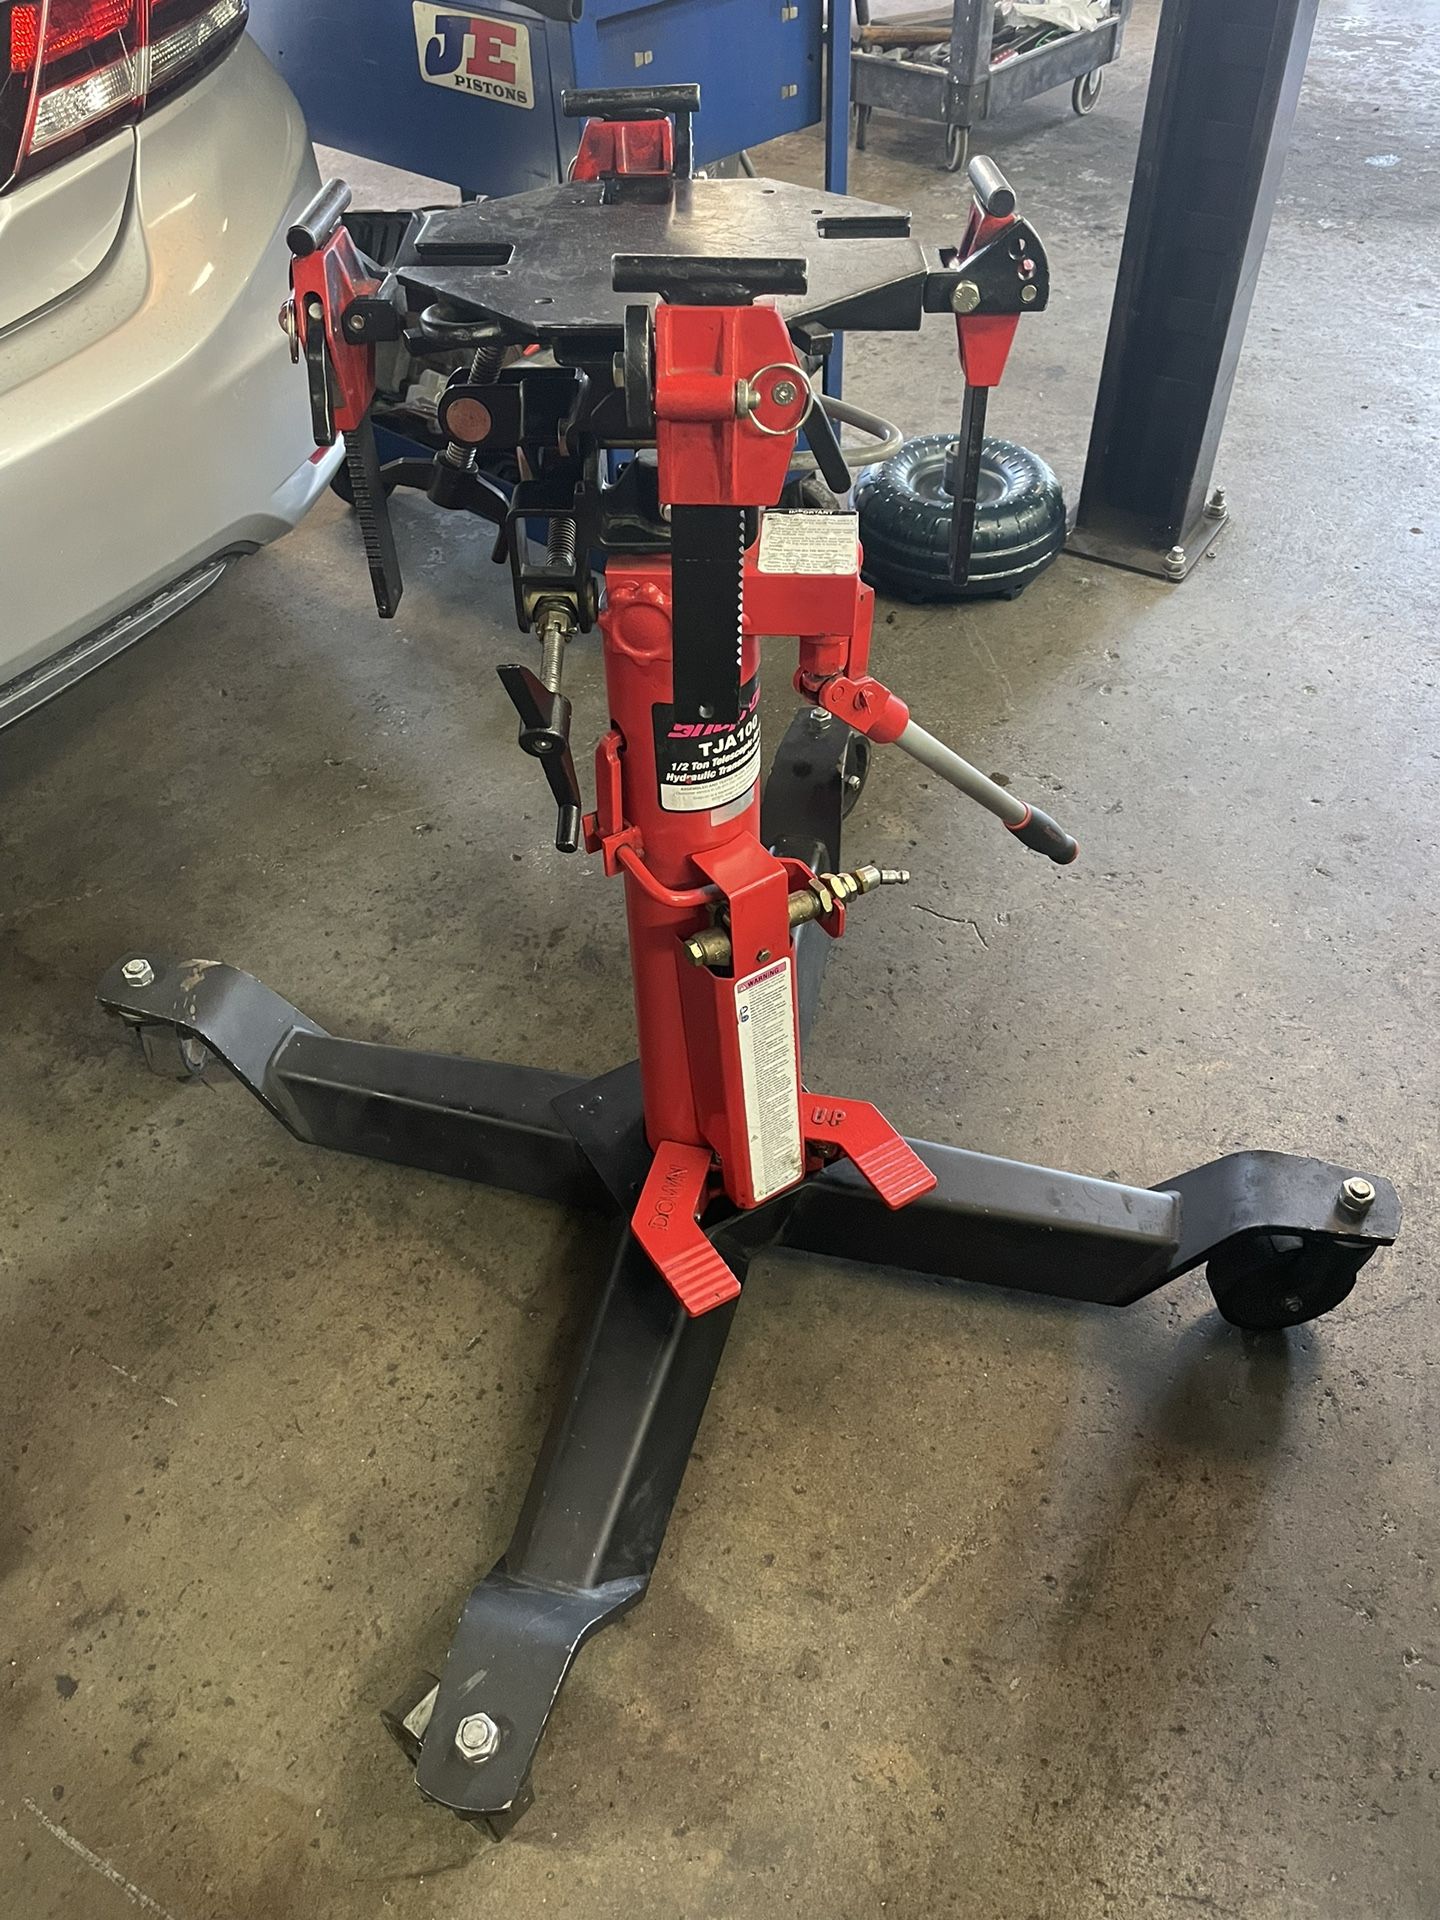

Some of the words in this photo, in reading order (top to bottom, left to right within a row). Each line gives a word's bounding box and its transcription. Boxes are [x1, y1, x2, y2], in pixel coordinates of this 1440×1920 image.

[425, 15, 517, 86] JE
[454, 75, 528, 104] PISTONS
[698, 713, 759, 757] TJA100
[665, 770, 717, 783] Hydraulic
[671, 762, 690, 772] 1/2
[691, 761, 710, 771] Ton
[747, 967, 780, 987] WARNING
[811, 1106, 847, 1126] UP
[648, 1164, 688, 1232] DOWN
